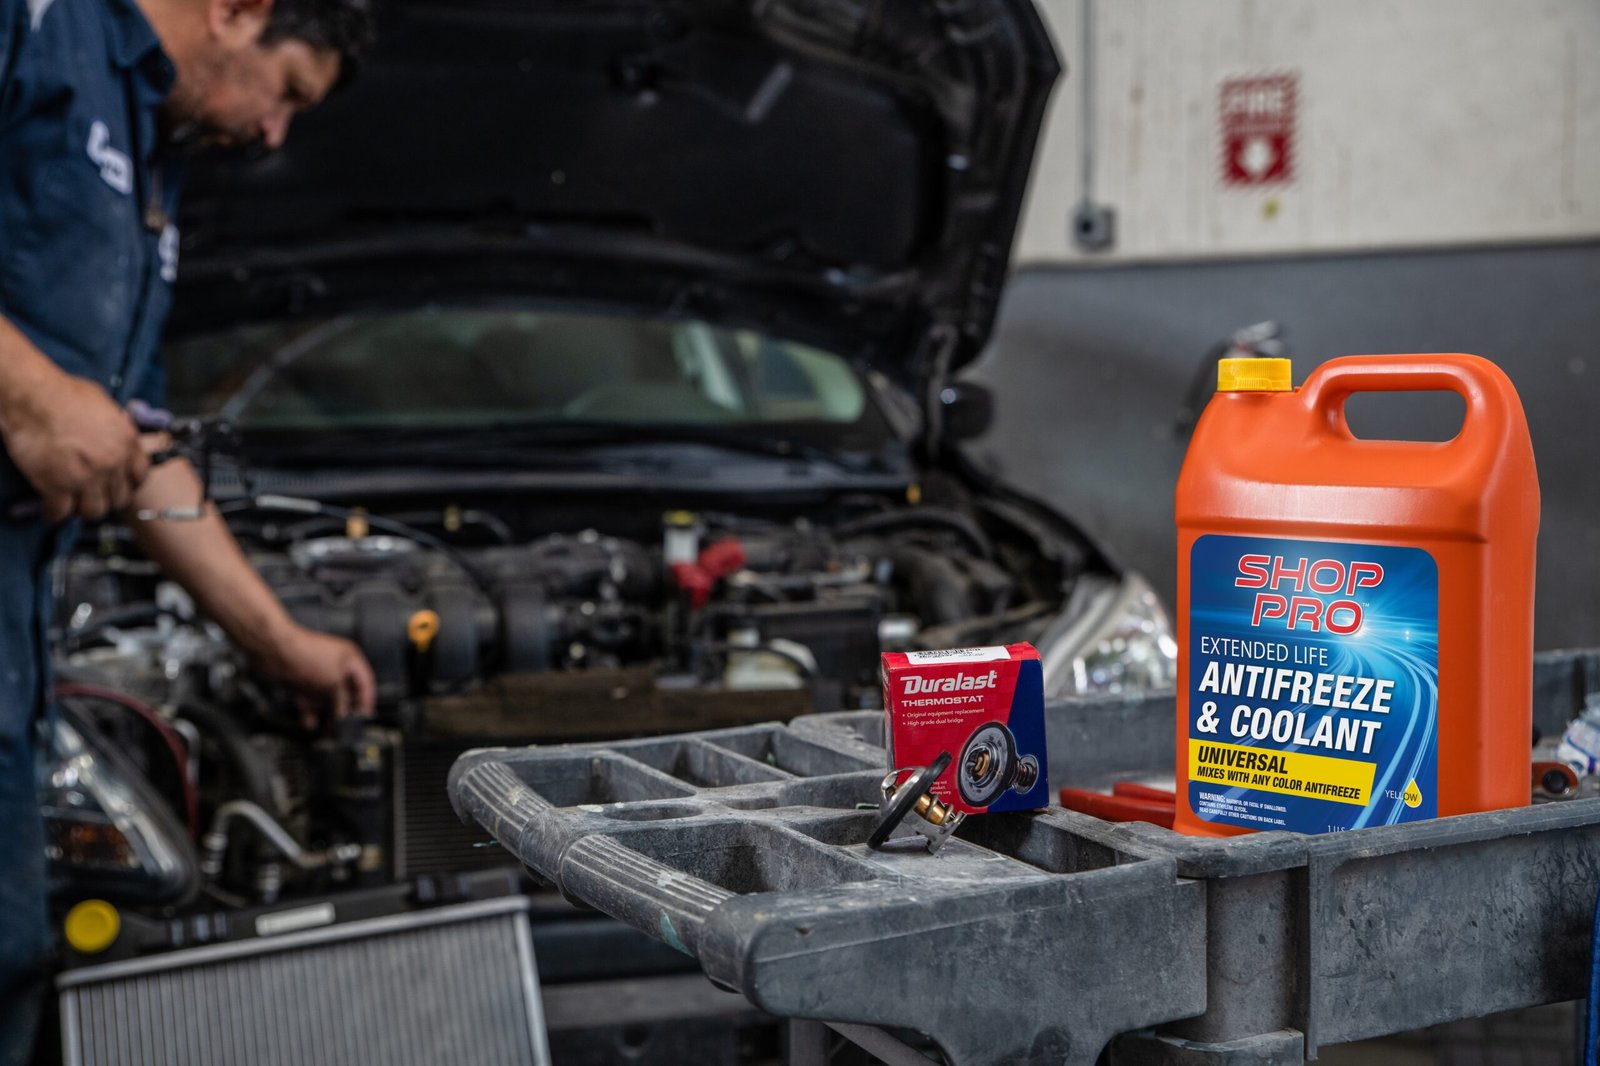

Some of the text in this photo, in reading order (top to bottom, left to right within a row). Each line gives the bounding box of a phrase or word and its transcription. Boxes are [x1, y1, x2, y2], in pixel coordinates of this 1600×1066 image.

[1235, 553, 1384, 596] SHOP
[1251, 592, 1363, 635] PRO
[1201, 636, 1328, 667] EXTENDED LIFE
[900, 670, 997, 695] Duralast
[1198, 661, 1395, 714] ANTIFREEZE
[901, 695, 984, 707] THERMOSTAT
[906, 711, 927, 719] Original
[947, 717, 964, 725] bridge
[1196, 701, 1382, 754] & COOLANT
[1198, 745, 1288, 774] UNIVERSAL
[1197, 766, 1361, 800] MIXES WITH ANY COLOR ANTIFREEZE
[1385, 789, 1418, 802] YELLOW
[1199, 791, 1226, 803] WARNING:
[1199, 800, 1216, 808] CONTAINS
[1216, 803, 1234, 811] ETHYLENE
[1208, 808, 1228, 816] CAREFULLY
[1240, 813, 1258, 821] CAUTIONS
